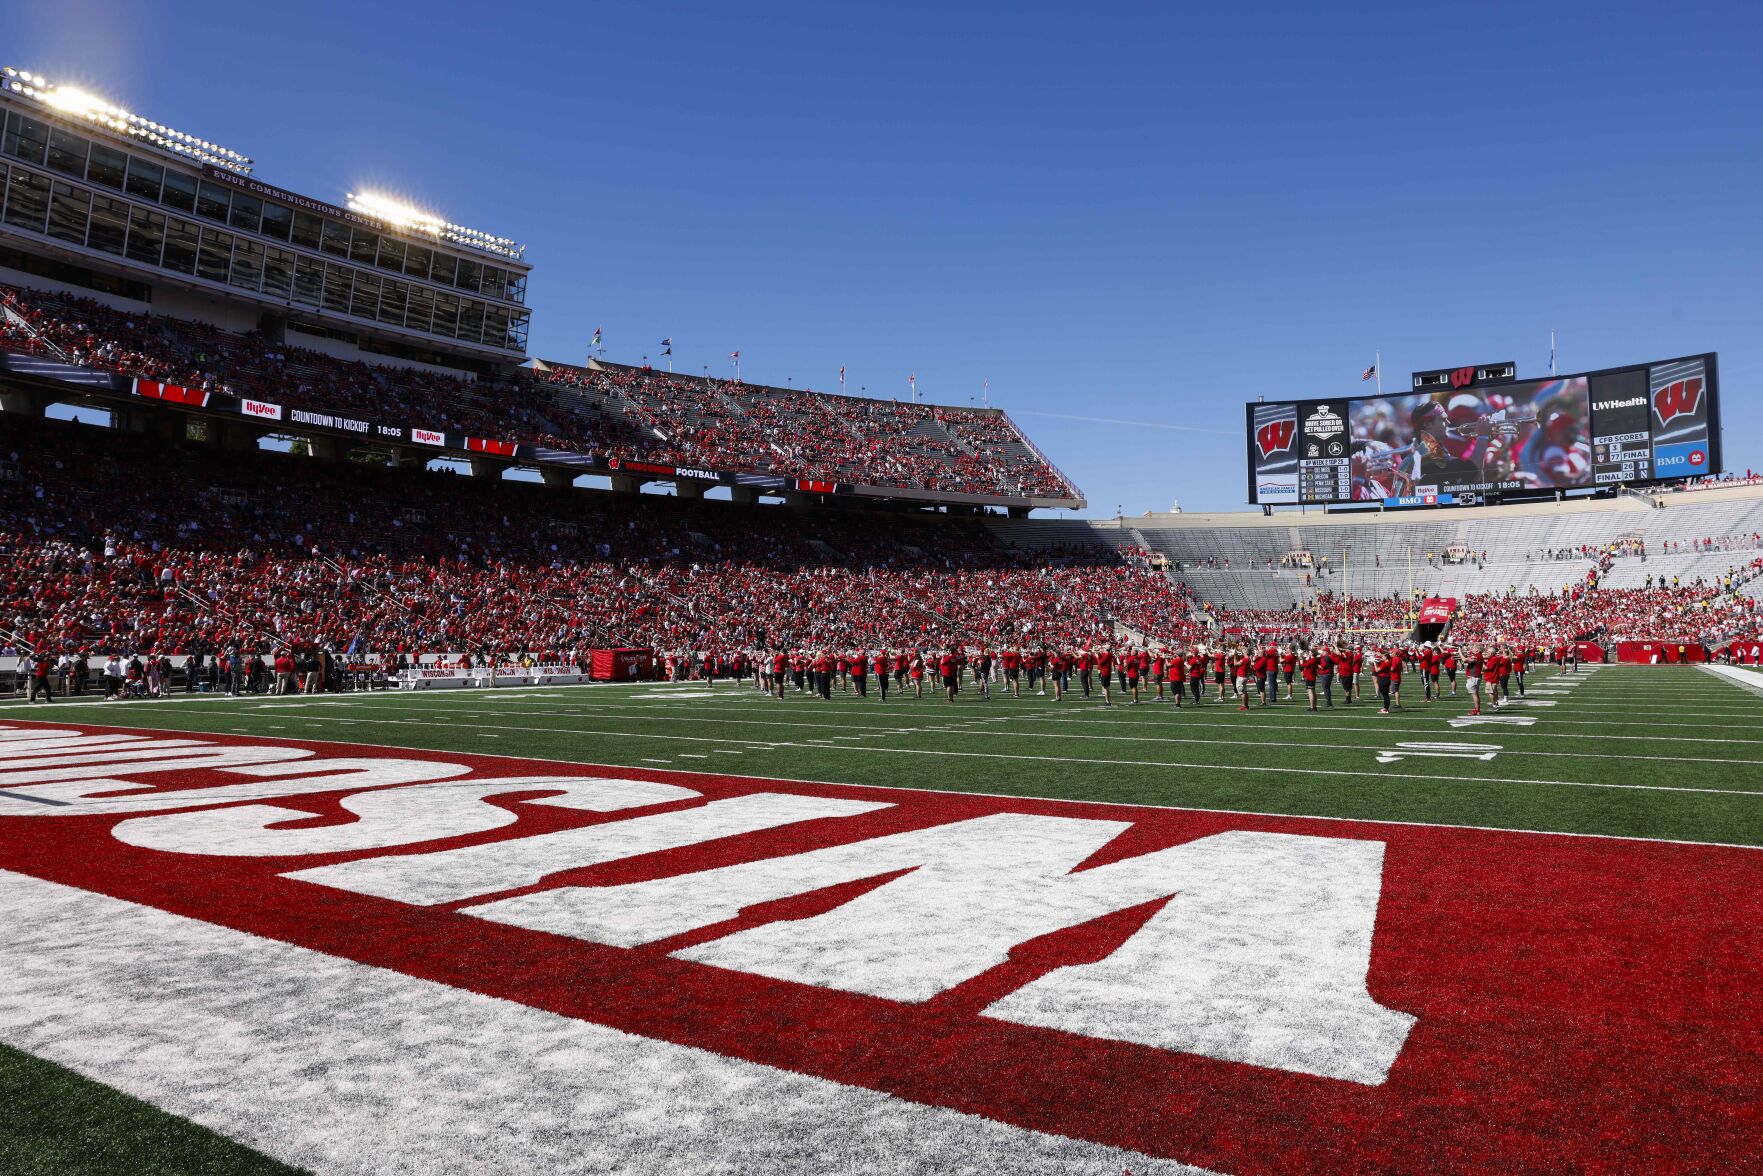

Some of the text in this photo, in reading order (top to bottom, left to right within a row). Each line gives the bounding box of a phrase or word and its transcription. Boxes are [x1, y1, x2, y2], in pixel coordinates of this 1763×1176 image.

[213, 170, 382, 230] EVJUE COMMUNICATIONS CENTER
[291, 409, 370, 434] COUNTDOWN TO KICKOFF
[377, 425, 402, 437] 18:05
[1599, 432, 1644, 444] CFB SCORES
[1623, 451, 1648, 459] FINAL
[1657, 455, 1685, 467] BMO
[625, 460, 676, 476] WISCONSIN
[676, 467, 720, 481] FOOTBALL
[1597, 473, 1621, 481] FINAL
[1443, 484, 1470, 493] COUNTDOWN
[1476, 482, 1494, 490] KICKOFF
[1497, 481, 1521, 489] 18:05
[1399, 497, 1421, 505] BMO
